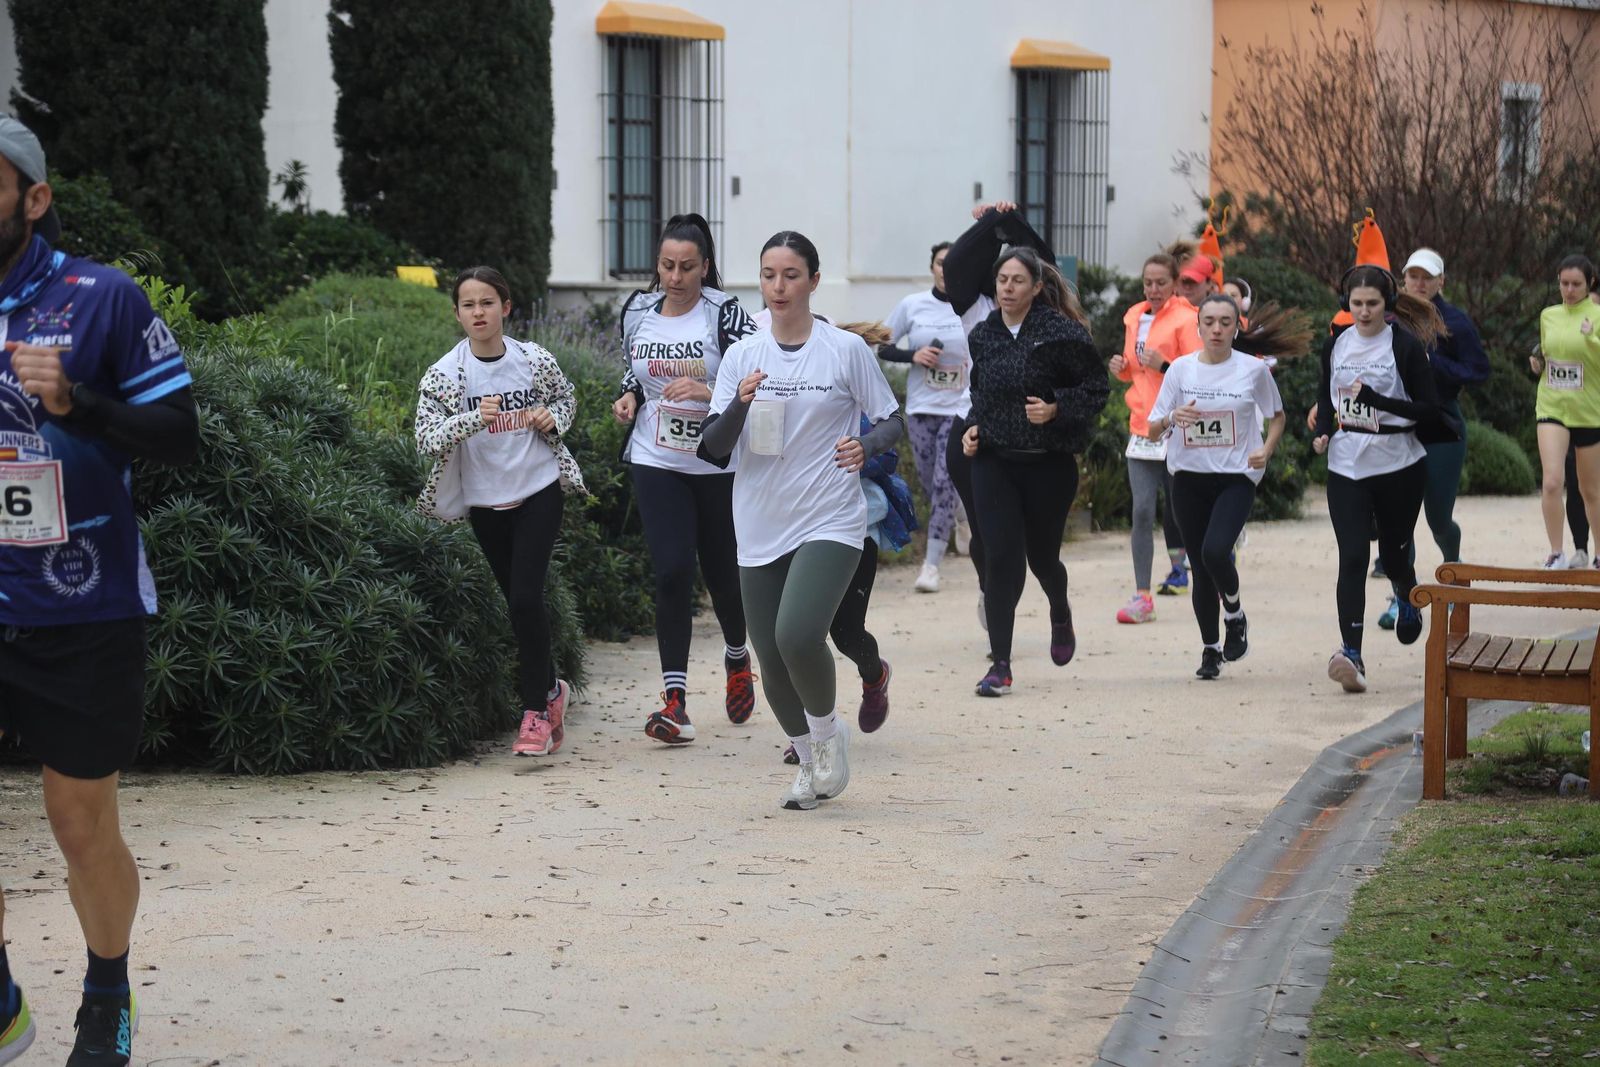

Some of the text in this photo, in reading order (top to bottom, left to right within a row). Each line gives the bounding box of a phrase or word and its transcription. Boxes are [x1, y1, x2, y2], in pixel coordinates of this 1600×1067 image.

[648, 360, 706, 377] amazonas
[929, 368, 959, 382] 127
[1343, 398, 1371, 418] 131
[670, 418, 700, 438] 35
[1195, 420, 1222, 435] 14
[0, 485, 33, 516] 6
[60, 550, 83, 559] VENI
[63, 562, 83, 570] VIDI
[66, 574, 84, 583] VICI
[116, 1007, 131, 1058] HOKA
